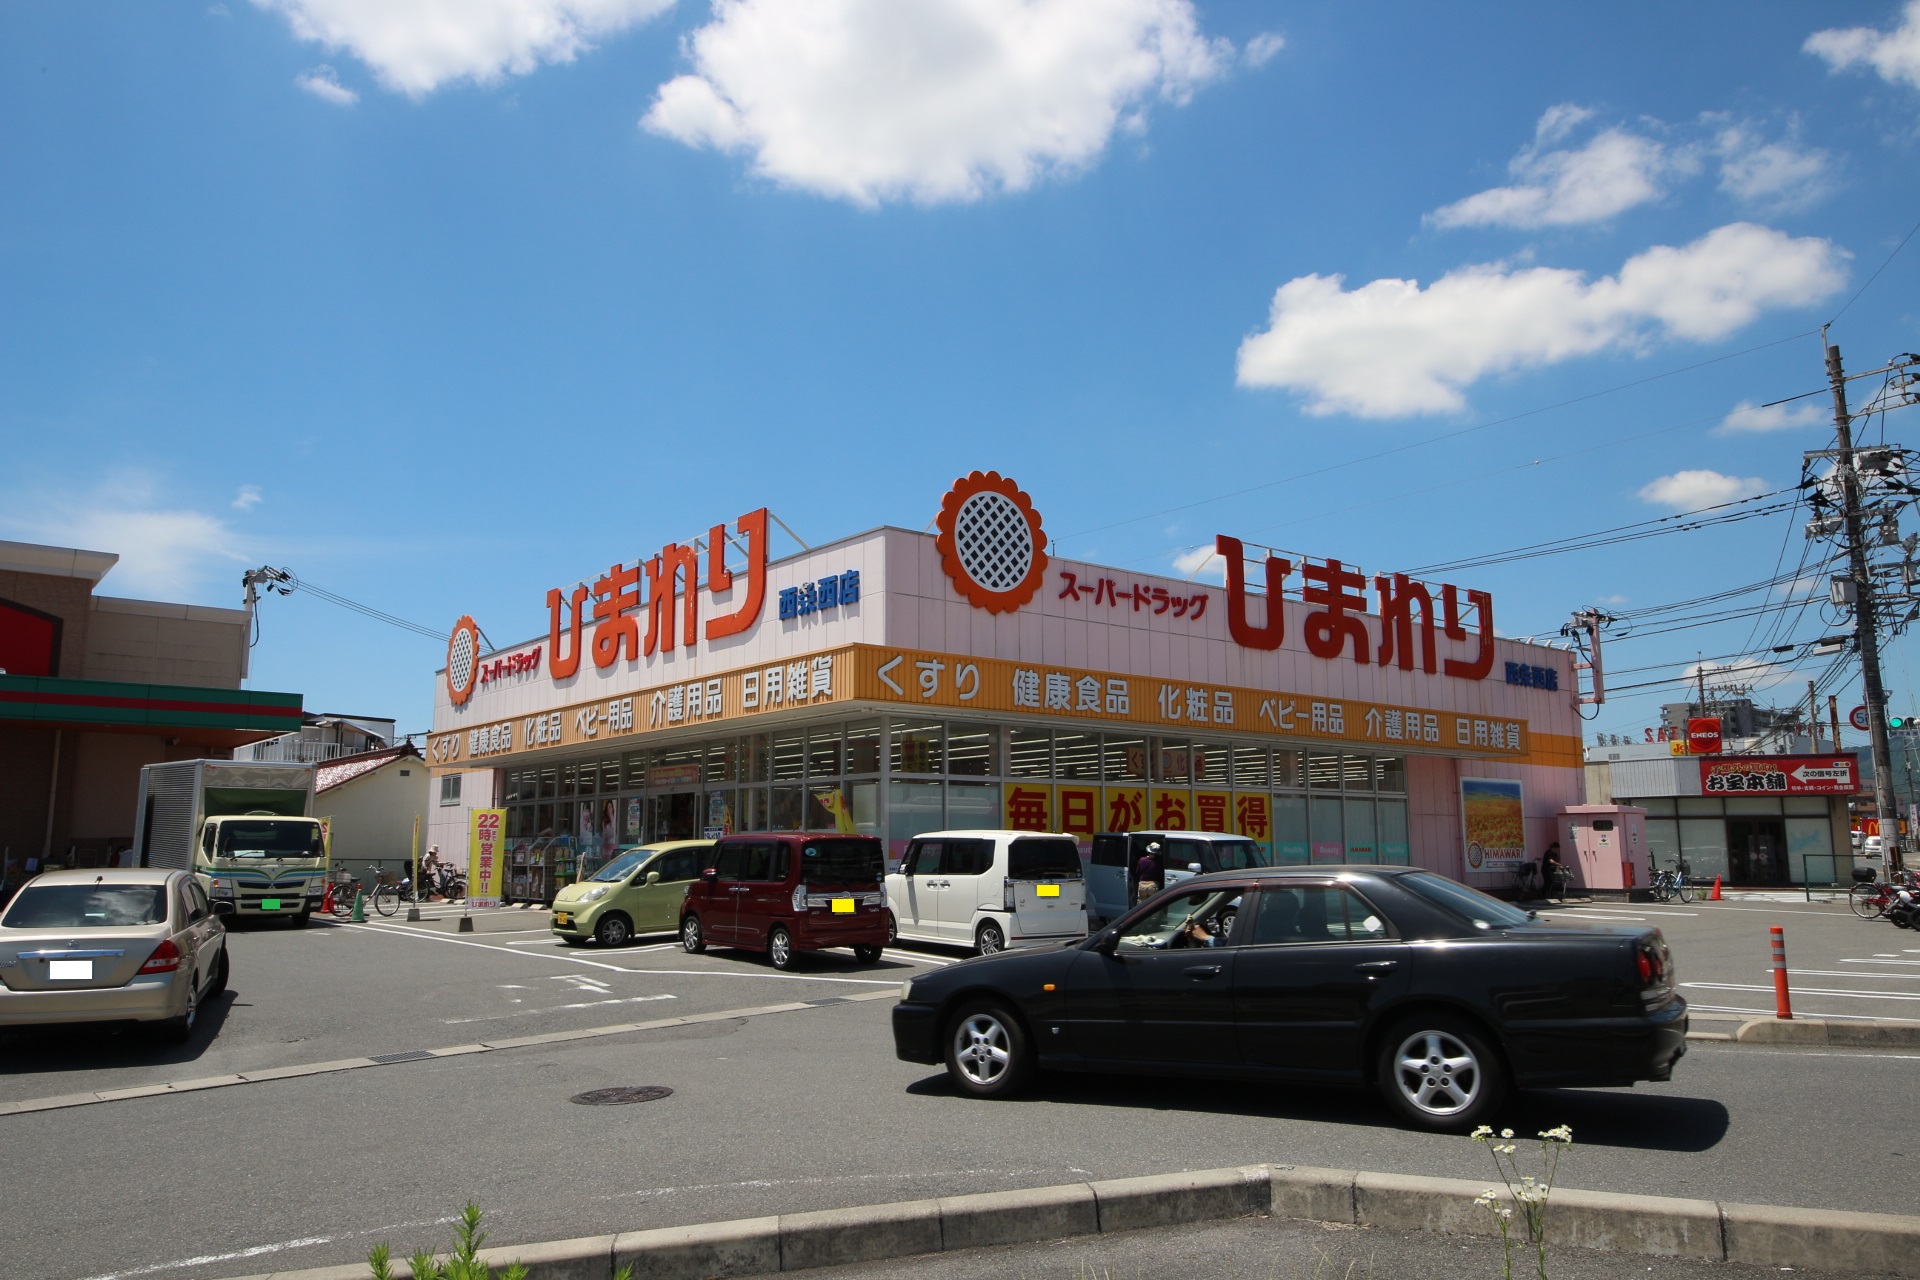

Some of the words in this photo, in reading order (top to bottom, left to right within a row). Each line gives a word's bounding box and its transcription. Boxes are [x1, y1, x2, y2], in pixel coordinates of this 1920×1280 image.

[546, 507, 768, 679] ひまわり
[1059, 572, 1208, 620] スーパードラッグ
[1216, 534, 1494, 681] ひまわり
[481, 646, 542, 683] スーパードラッグ
[432, 733, 460, 762] くすり
[468, 722, 512, 755] 健康食品
[524, 712, 562, 746] 化粧品
[575, 697, 633, 735] ベビー用品
[650, 678, 722, 726] 介護用品
[743, 656, 833, 708] 日用雑貨
[877, 656, 979, 700] くすり
[1012, 667, 1130, 715] 健康食品
[1158, 684, 1234, 725] 化粧品
[1259, 697, 1344, 734] ベビー用品
[1364, 707, 1440, 743] 介護用品
[1455, 718, 1521, 750] 日用雑貨
[1706, 772, 1787, 791] お宝本舗
[1007, 787, 1269, 838] 毎日がお買得
[1484, 848, 1524, 859] HIMAWARI
